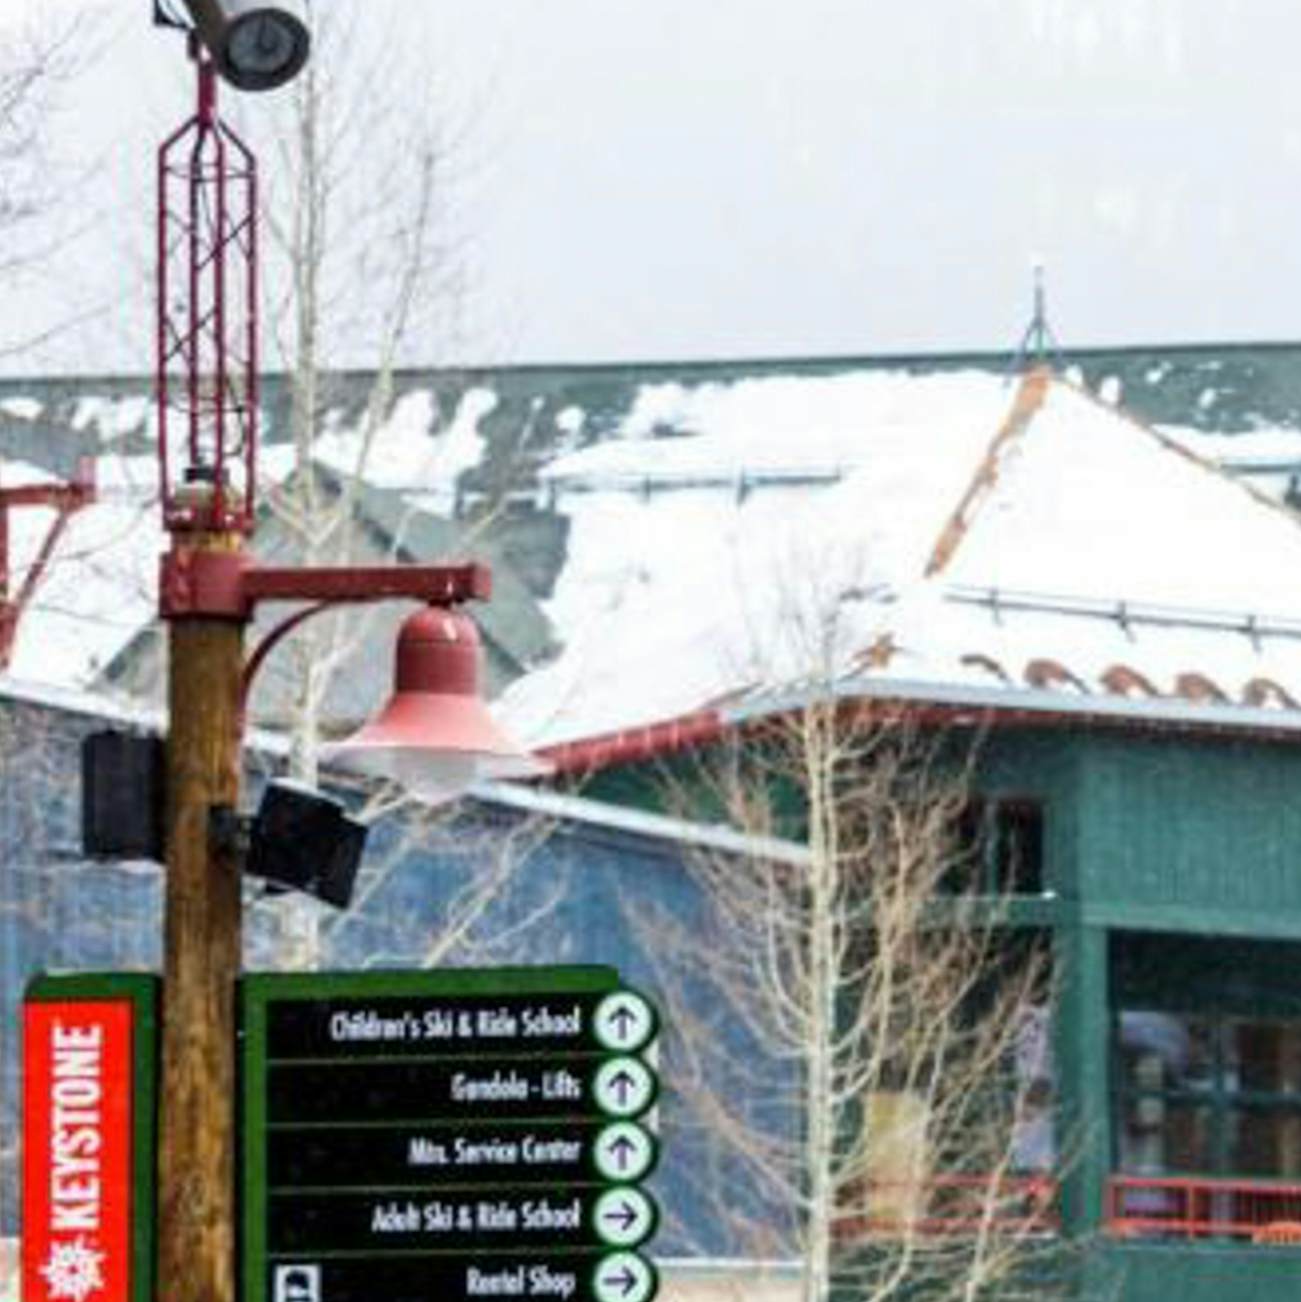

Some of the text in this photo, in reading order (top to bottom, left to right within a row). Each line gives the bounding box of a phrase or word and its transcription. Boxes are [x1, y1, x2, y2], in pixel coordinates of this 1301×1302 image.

[331, 1005, 580, 1041] Children's Ski & Ride School
[451, 1071, 529, 1101] Gondola
[542, 1070, 580, 1099] Lifts
[51, 1020, 102, 1231] KEYSTONE
[455, 1137, 517, 1164] Service
[522, 1135, 580, 1163] Center
[371, 1198, 580, 1231] Adult Ski & Ride School
[467, 1265, 576, 1299] Rental Shop
